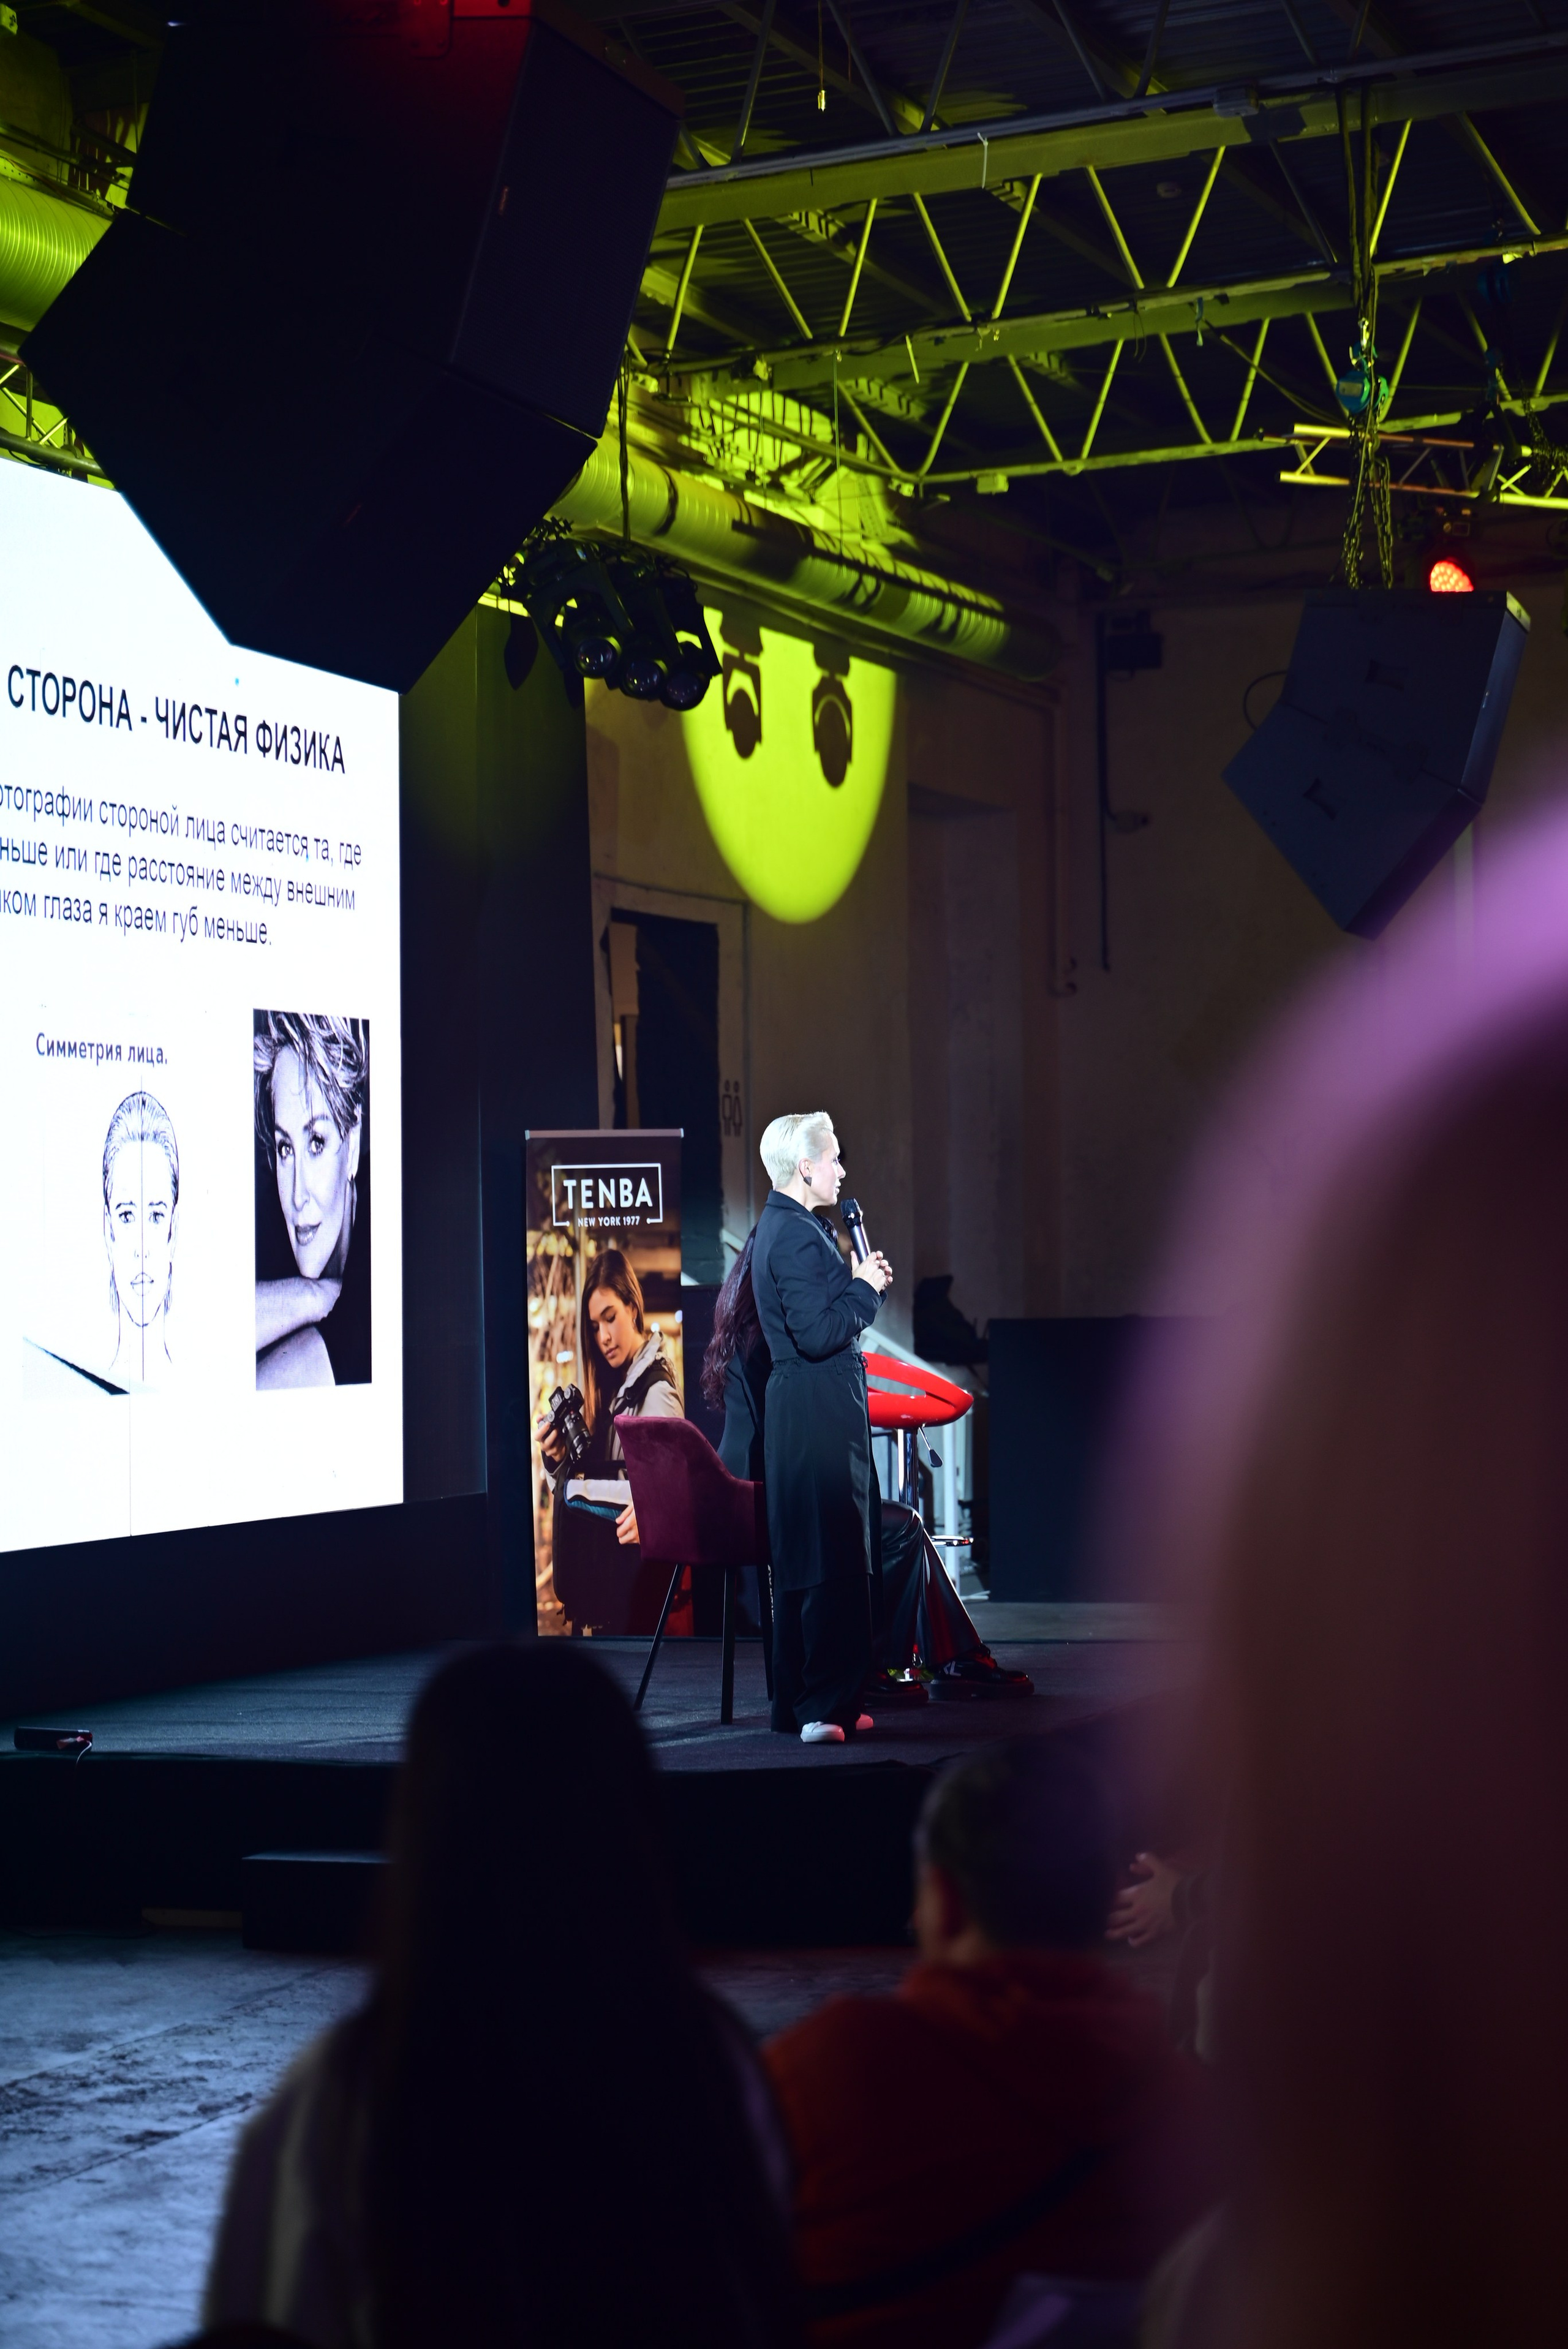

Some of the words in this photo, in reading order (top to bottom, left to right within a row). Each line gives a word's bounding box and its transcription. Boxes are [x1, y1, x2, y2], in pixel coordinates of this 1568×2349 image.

[7, 664, 133, 731] СТОРОНА
[155, 696, 247, 755] ЧИСТАЯ
[255, 720, 345, 774] ФИЗИКА
[99, 801, 179, 837] стороной
[185, 816, 225, 850] лица
[231, 823, 308, 857] считается
[314, 837, 334, 866] та,
[339, 842, 361, 870] где
[55, 845, 87, 872] или
[95, 851, 121, 883] где
[128, 855, 225, 891] расстояние
[231, 872, 282, 907] между
[287, 880, 355, 910] внешним
[0, 889, 36, 917] ком
[44, 895, 92, 924] глаза
[99, 902, 108, 926] я
[115, 904, 167, 937] краем
[172, 905, 198, 943] губ
[204, 916, 272, 946] меньше.
[36, 1032, 123, 1067] Симметрия
[127, 1046, 168, 1068] лица.
[563, 1177, 653, 1209] TENBA
[578, 1216, 595, 1227] NEW
[598, 1216, 621, 1227] YORK
[623, 1216, 640, 1226] 1977
